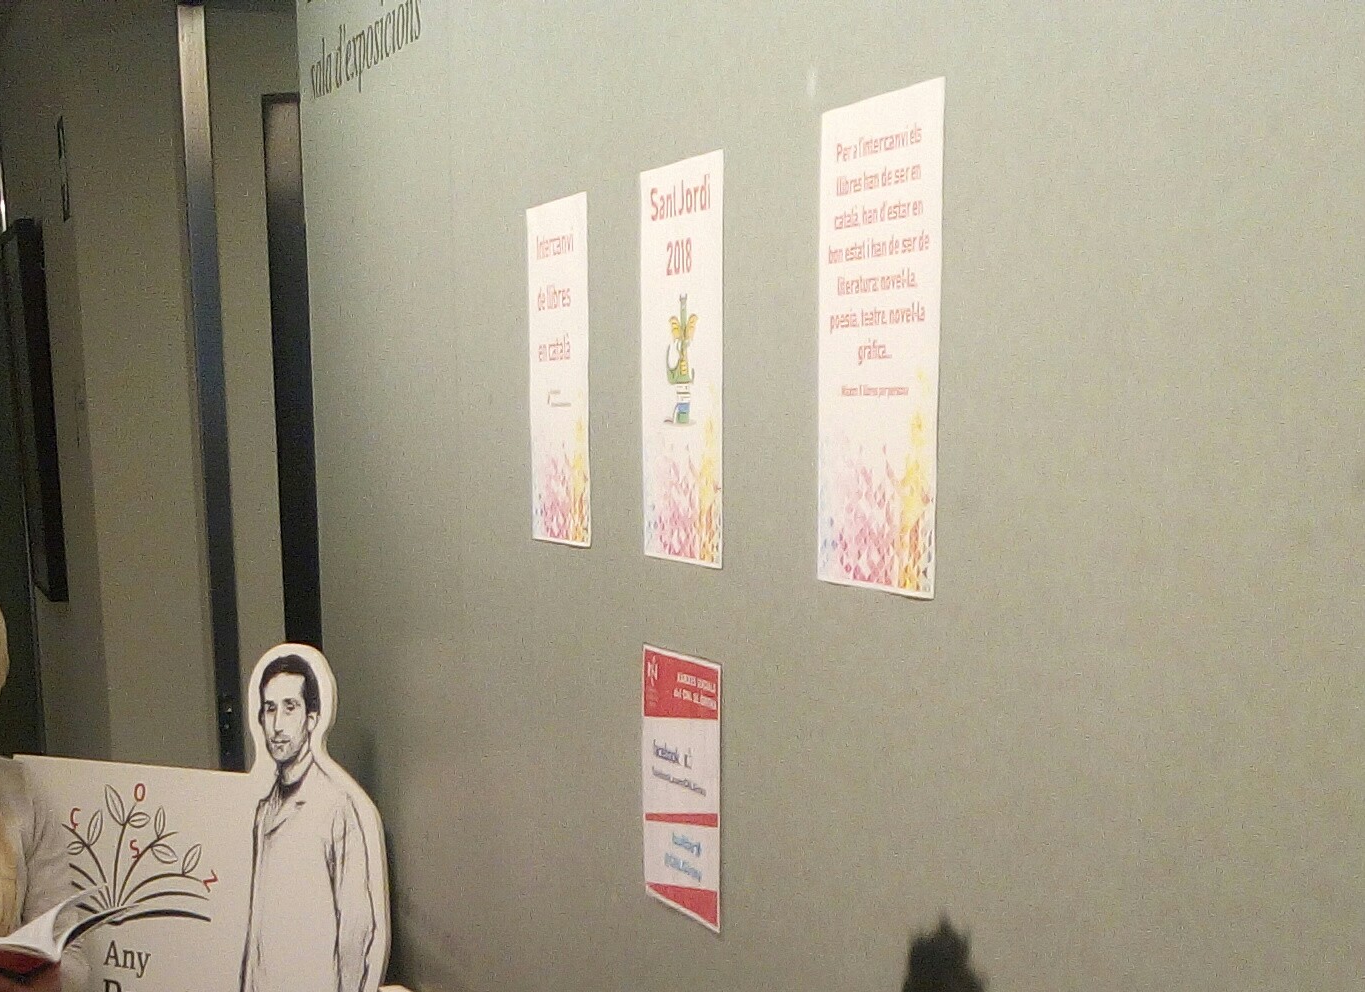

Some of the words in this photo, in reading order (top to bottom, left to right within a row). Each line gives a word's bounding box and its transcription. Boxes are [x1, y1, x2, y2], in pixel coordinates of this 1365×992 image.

[836, 142, 852, 163] Per
[909, 122, 923, 144] els
[863, 169, 879, 190] han
[881, 165, 892, 187] de
[894, 166, 910, 185] ser
[911, 163, 922, 181] en
[649, 185, 676, 222] Sant
[677, 173, 711, 216] Jordi
[862, 206, 878, 225] han
[912, 199, 924, 216] en
[536, 231, 574, 261] Intercanvi
[666, 237, 693, 276] 2018
[828, 243, 843, 264] bon
[844, 241, 865, 262] estat
[871, 237, 887, 257] han
[888, 234, 899, 255] de
[901, 235, 916, 253] ser
[918, 231, 930, 250] de
[537, 287, 546, 312] de
[547, 286, 571, 309] llibres
[538, 341, 547, 362] en
[548, 333, 571, 361] català
[103, 940, 151, 978] Any
